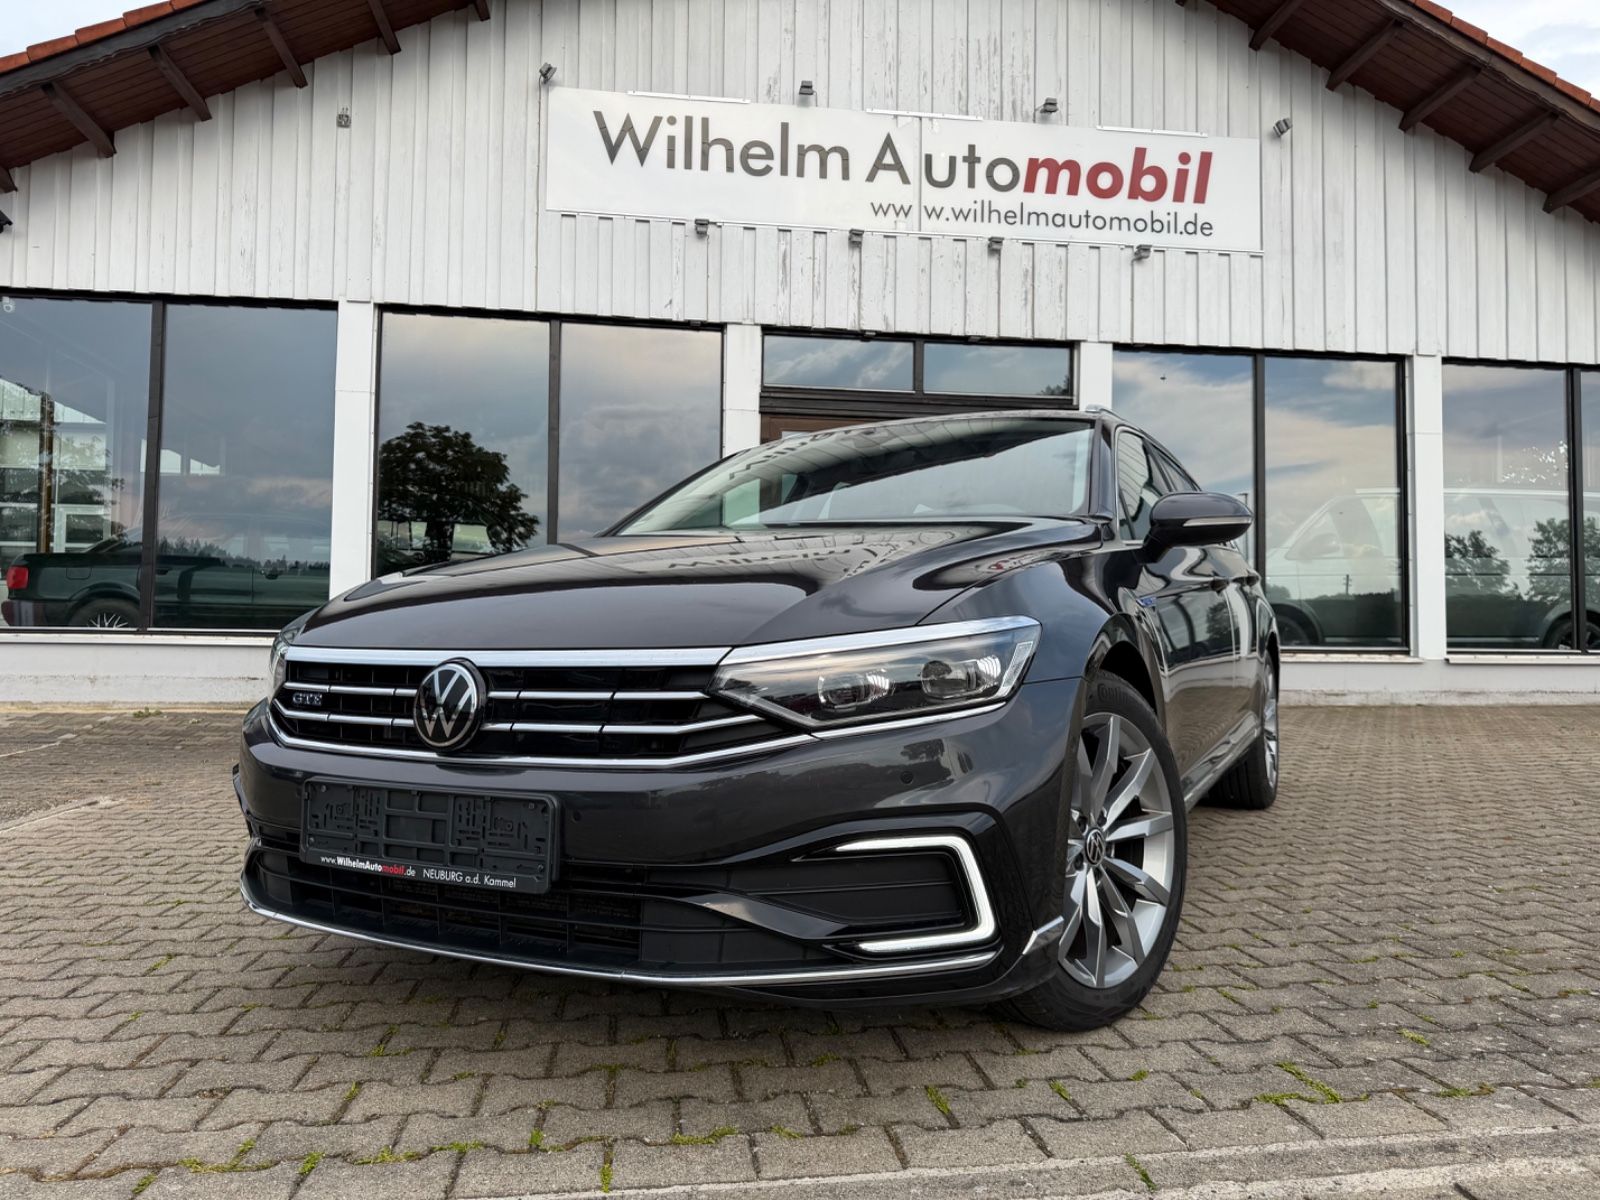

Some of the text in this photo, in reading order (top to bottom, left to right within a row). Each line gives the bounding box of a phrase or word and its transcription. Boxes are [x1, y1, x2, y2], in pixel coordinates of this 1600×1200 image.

[593, 110, 851, 181] Wilhelm
[870, 200, 1214, 237] www.wilhelmautomobil.de
[320, 856, 517, 888] www.WilhelmAutomobil.de NEUBURG a.d. Kammel
